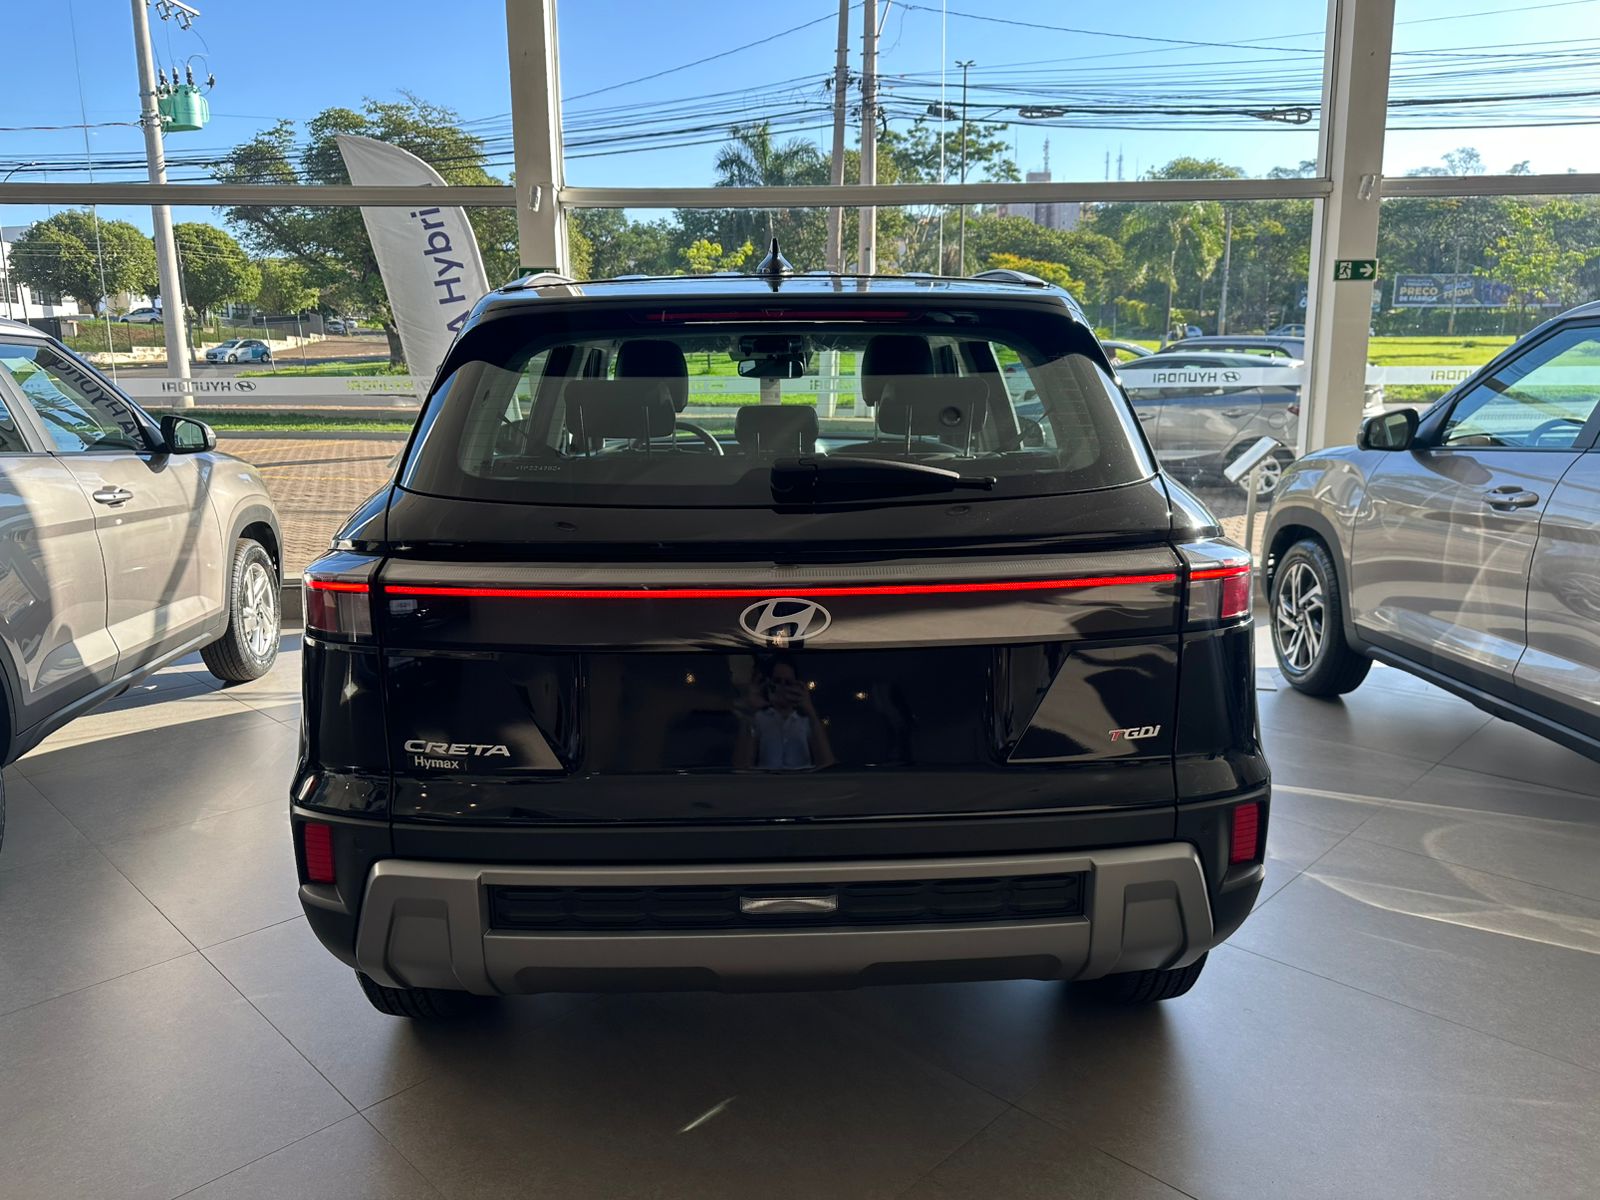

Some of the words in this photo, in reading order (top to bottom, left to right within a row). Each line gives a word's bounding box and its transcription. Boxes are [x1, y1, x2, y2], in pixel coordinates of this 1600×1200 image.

[410, 183, 466, 305] Hybri
[404, 740, 511, 757] CRETA
[414, 755, 460, 770] Hymax
